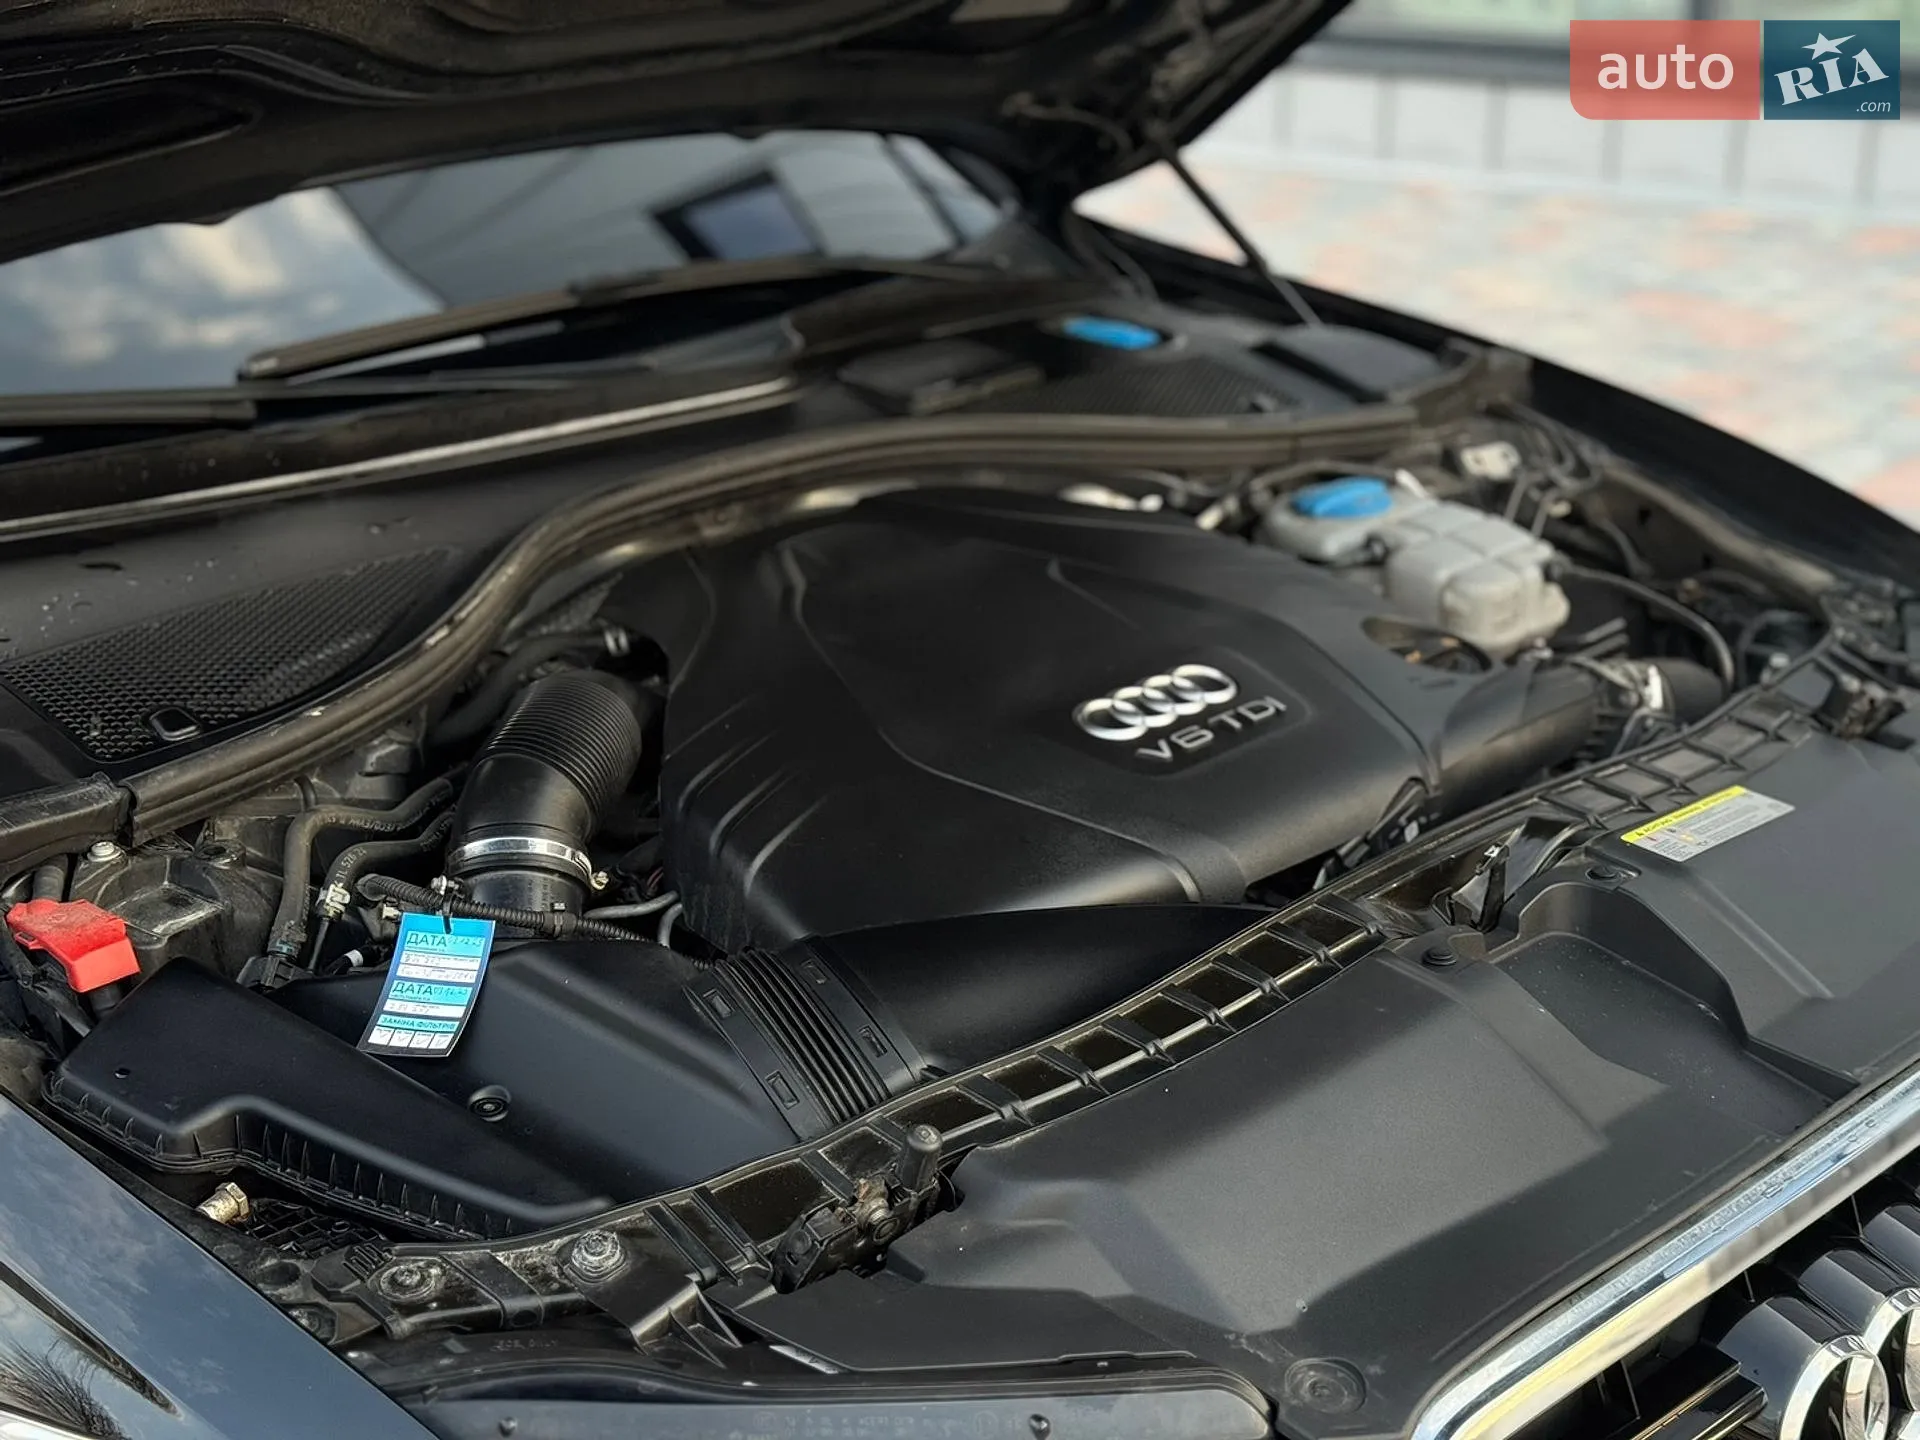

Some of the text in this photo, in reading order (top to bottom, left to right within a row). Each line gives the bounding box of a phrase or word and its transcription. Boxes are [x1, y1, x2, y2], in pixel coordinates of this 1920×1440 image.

[1135, 695, 1288, 762] V6 TDI
[406, 932, 447, 948] ДАТА
[392, 981, 433, 996] ДАТА
